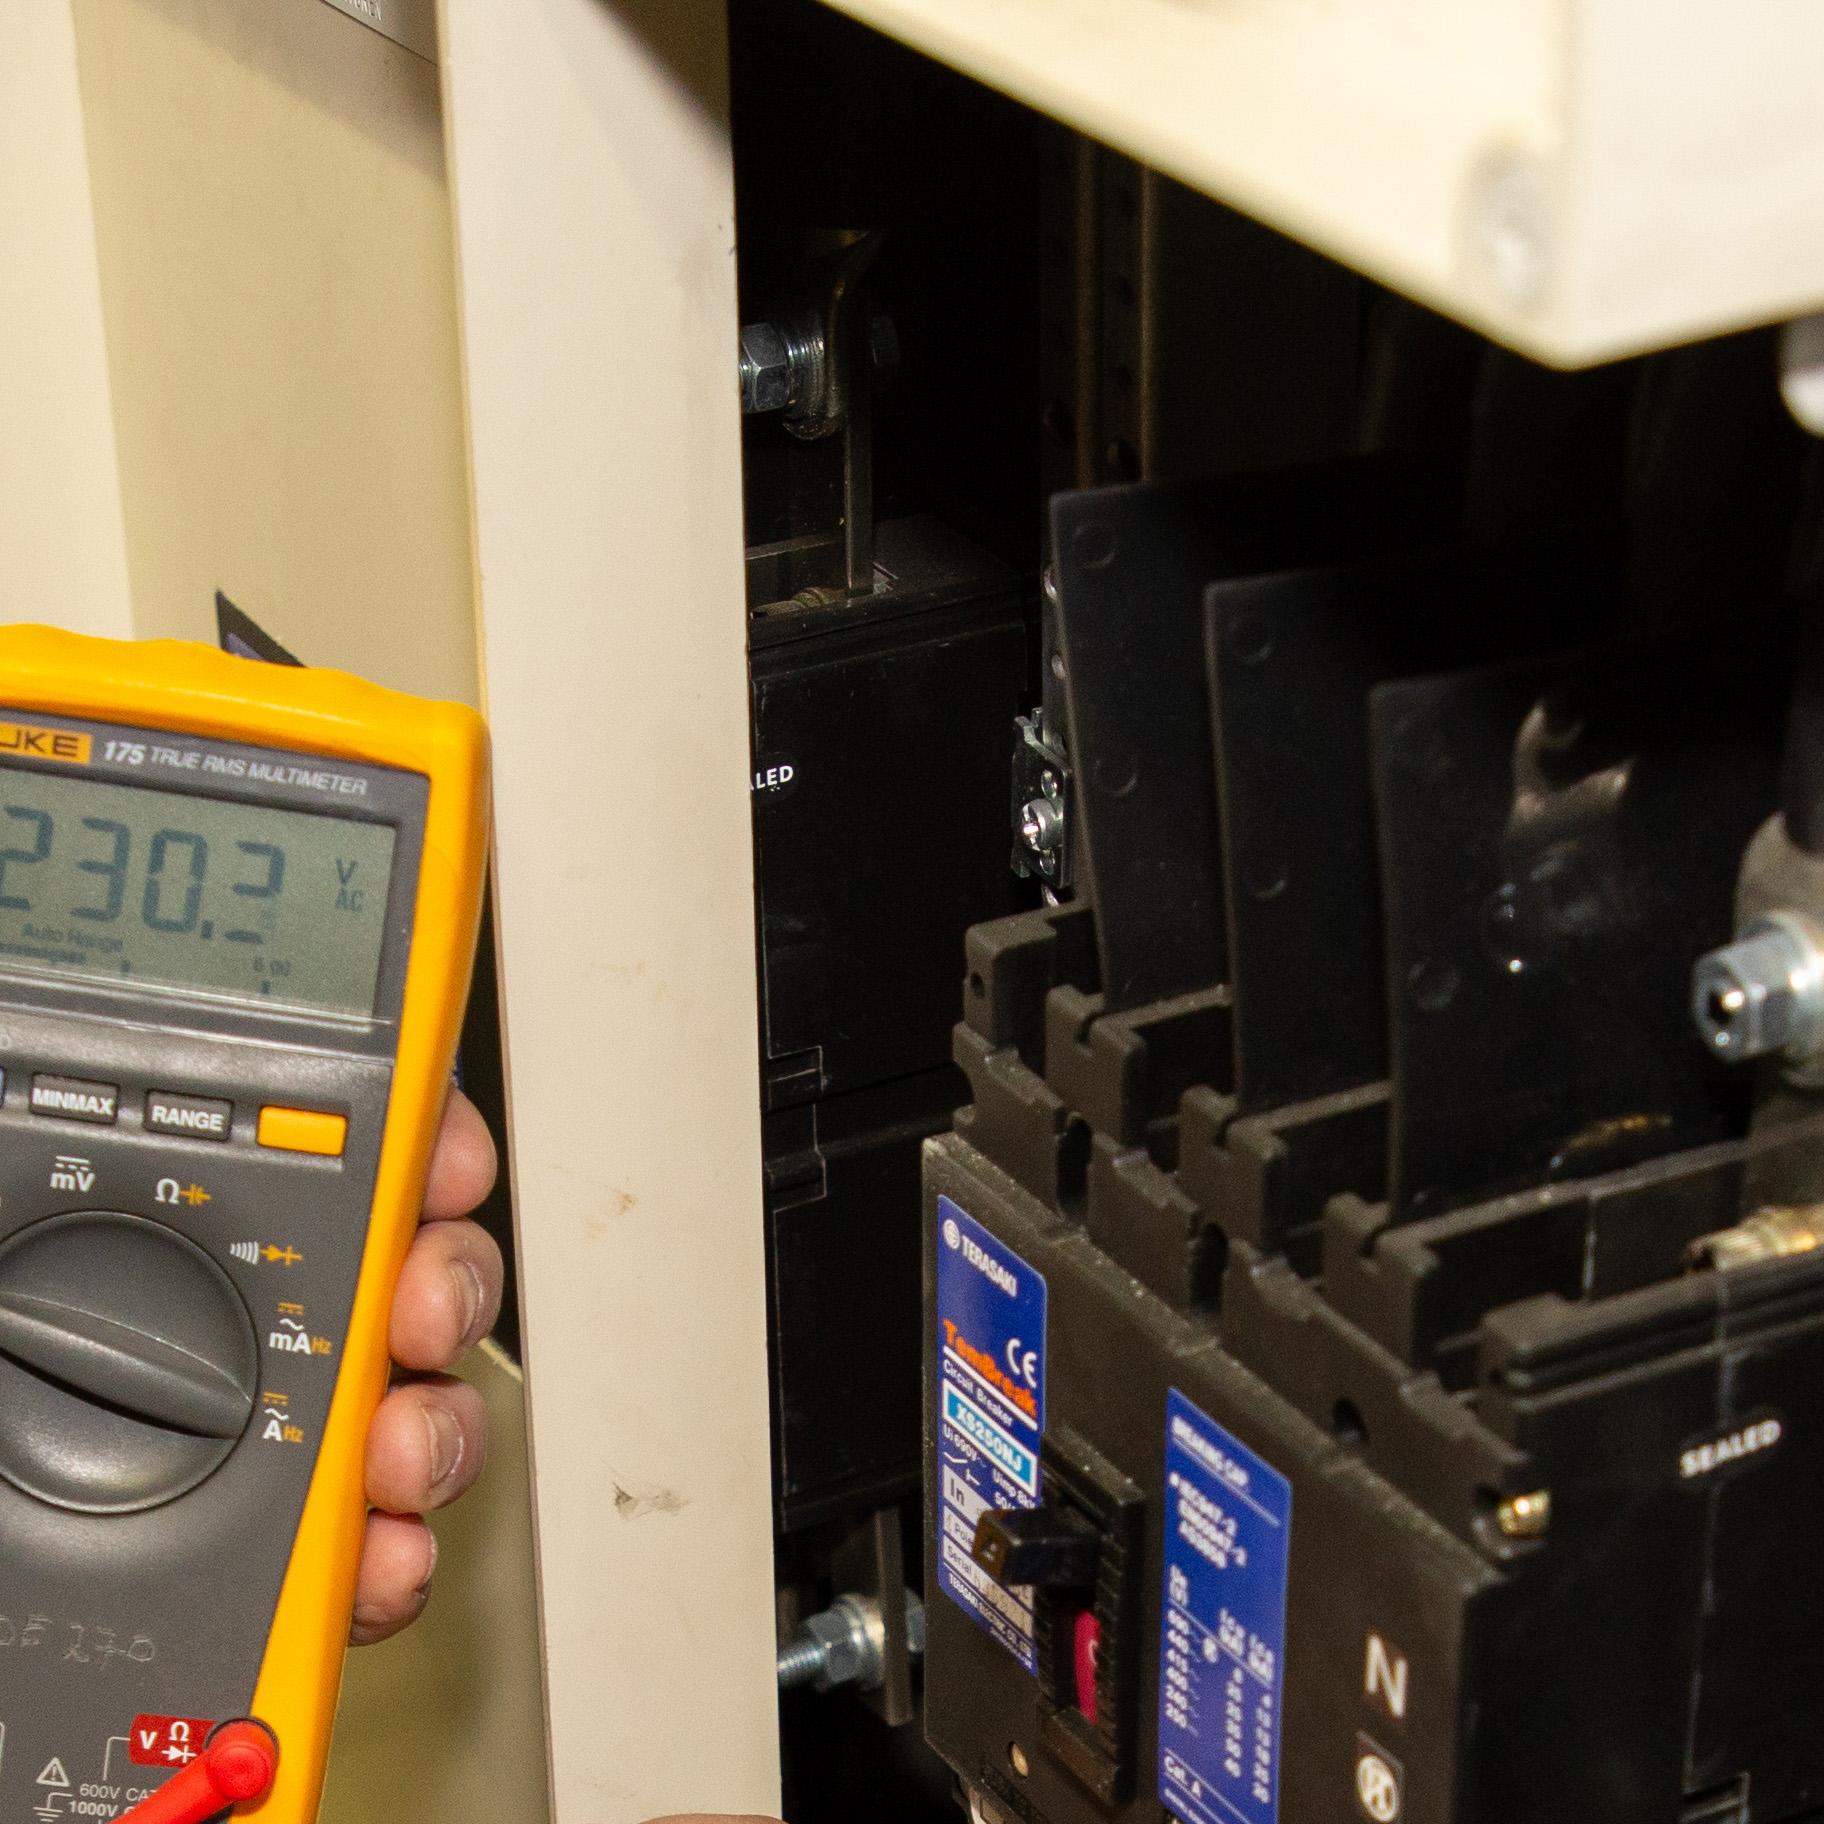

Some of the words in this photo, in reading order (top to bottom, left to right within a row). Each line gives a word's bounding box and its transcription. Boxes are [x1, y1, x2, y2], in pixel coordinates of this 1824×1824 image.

[102, 739, 145, 765] 175
[150, 746, 197, 770] TRUE
[202, 754, 246, 778] RMS
[248, 761, 367, 796] MULTIMETER
[751, 765, 794, 791] LED
[32, 1086, 114, 1117] MINMAX
[152, 1104, 224, 1133] RANGE
[49, 1168, 95, 1192] mV
[961, 1234, 1018, 1298] TERASAKI
[268, 1330, 311, 1355] mA
[942, 1317, 1037, 1419] TemBreak
[942, 1358, 975, 1395] Circuit
[976, 1386, 1014, 1428] Breaker
[262, 1418, 283, 1442] A
[1679, 1418, 1782, 1480] SEALED
[949, 1478, 966, 1507] In
[1364, 1633, 1409, 1719] N
[138, 1729, 157, 1750] V
[79, 1783, 120, 1800] 600V
[69, 1800, 118, 1818] 1000V
